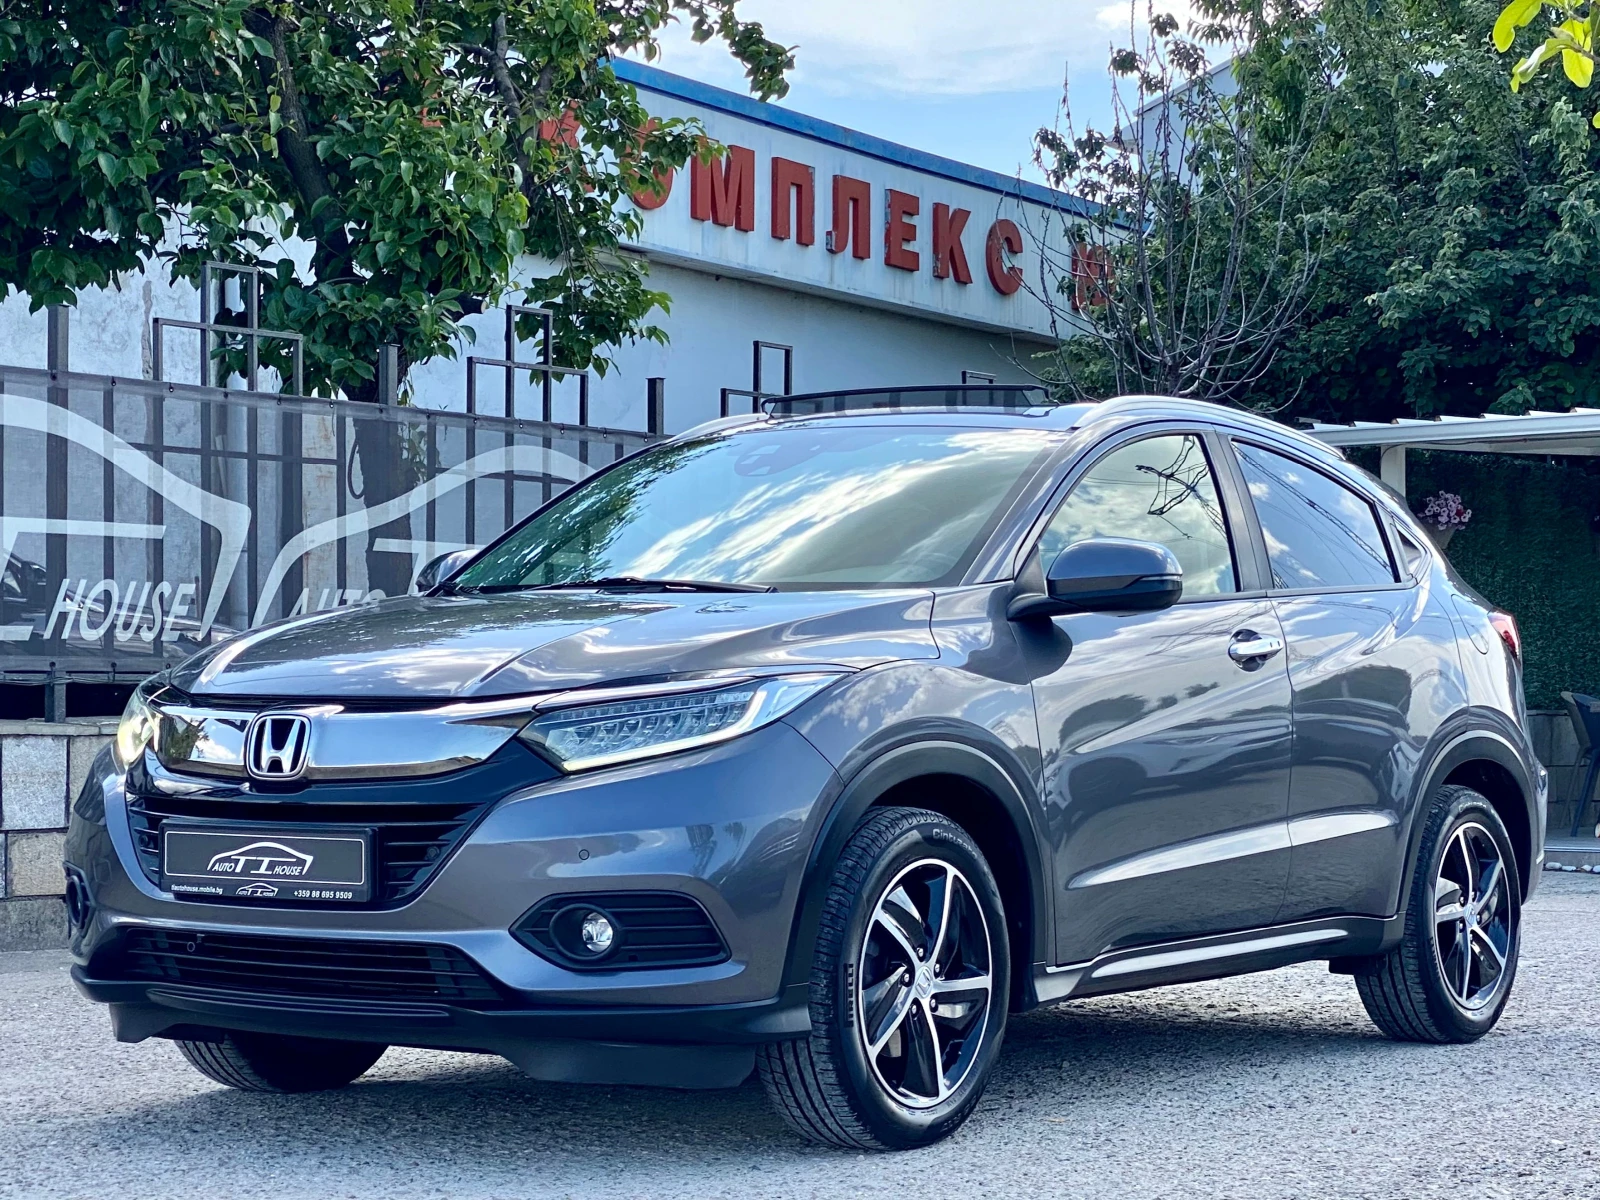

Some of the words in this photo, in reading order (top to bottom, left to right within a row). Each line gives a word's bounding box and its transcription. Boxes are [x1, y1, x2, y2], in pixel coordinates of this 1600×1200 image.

[43, 578, 196, 642] HOUSE
[212, 862, 235, 872] AUTO
[273, 865, 302, 875] HOUSE
[294, 890, 310, 898] +359
[311, 890, 320, 898] 88
[321, 891, 334, 899] 695
[335, 891, 352, 900] 9509
